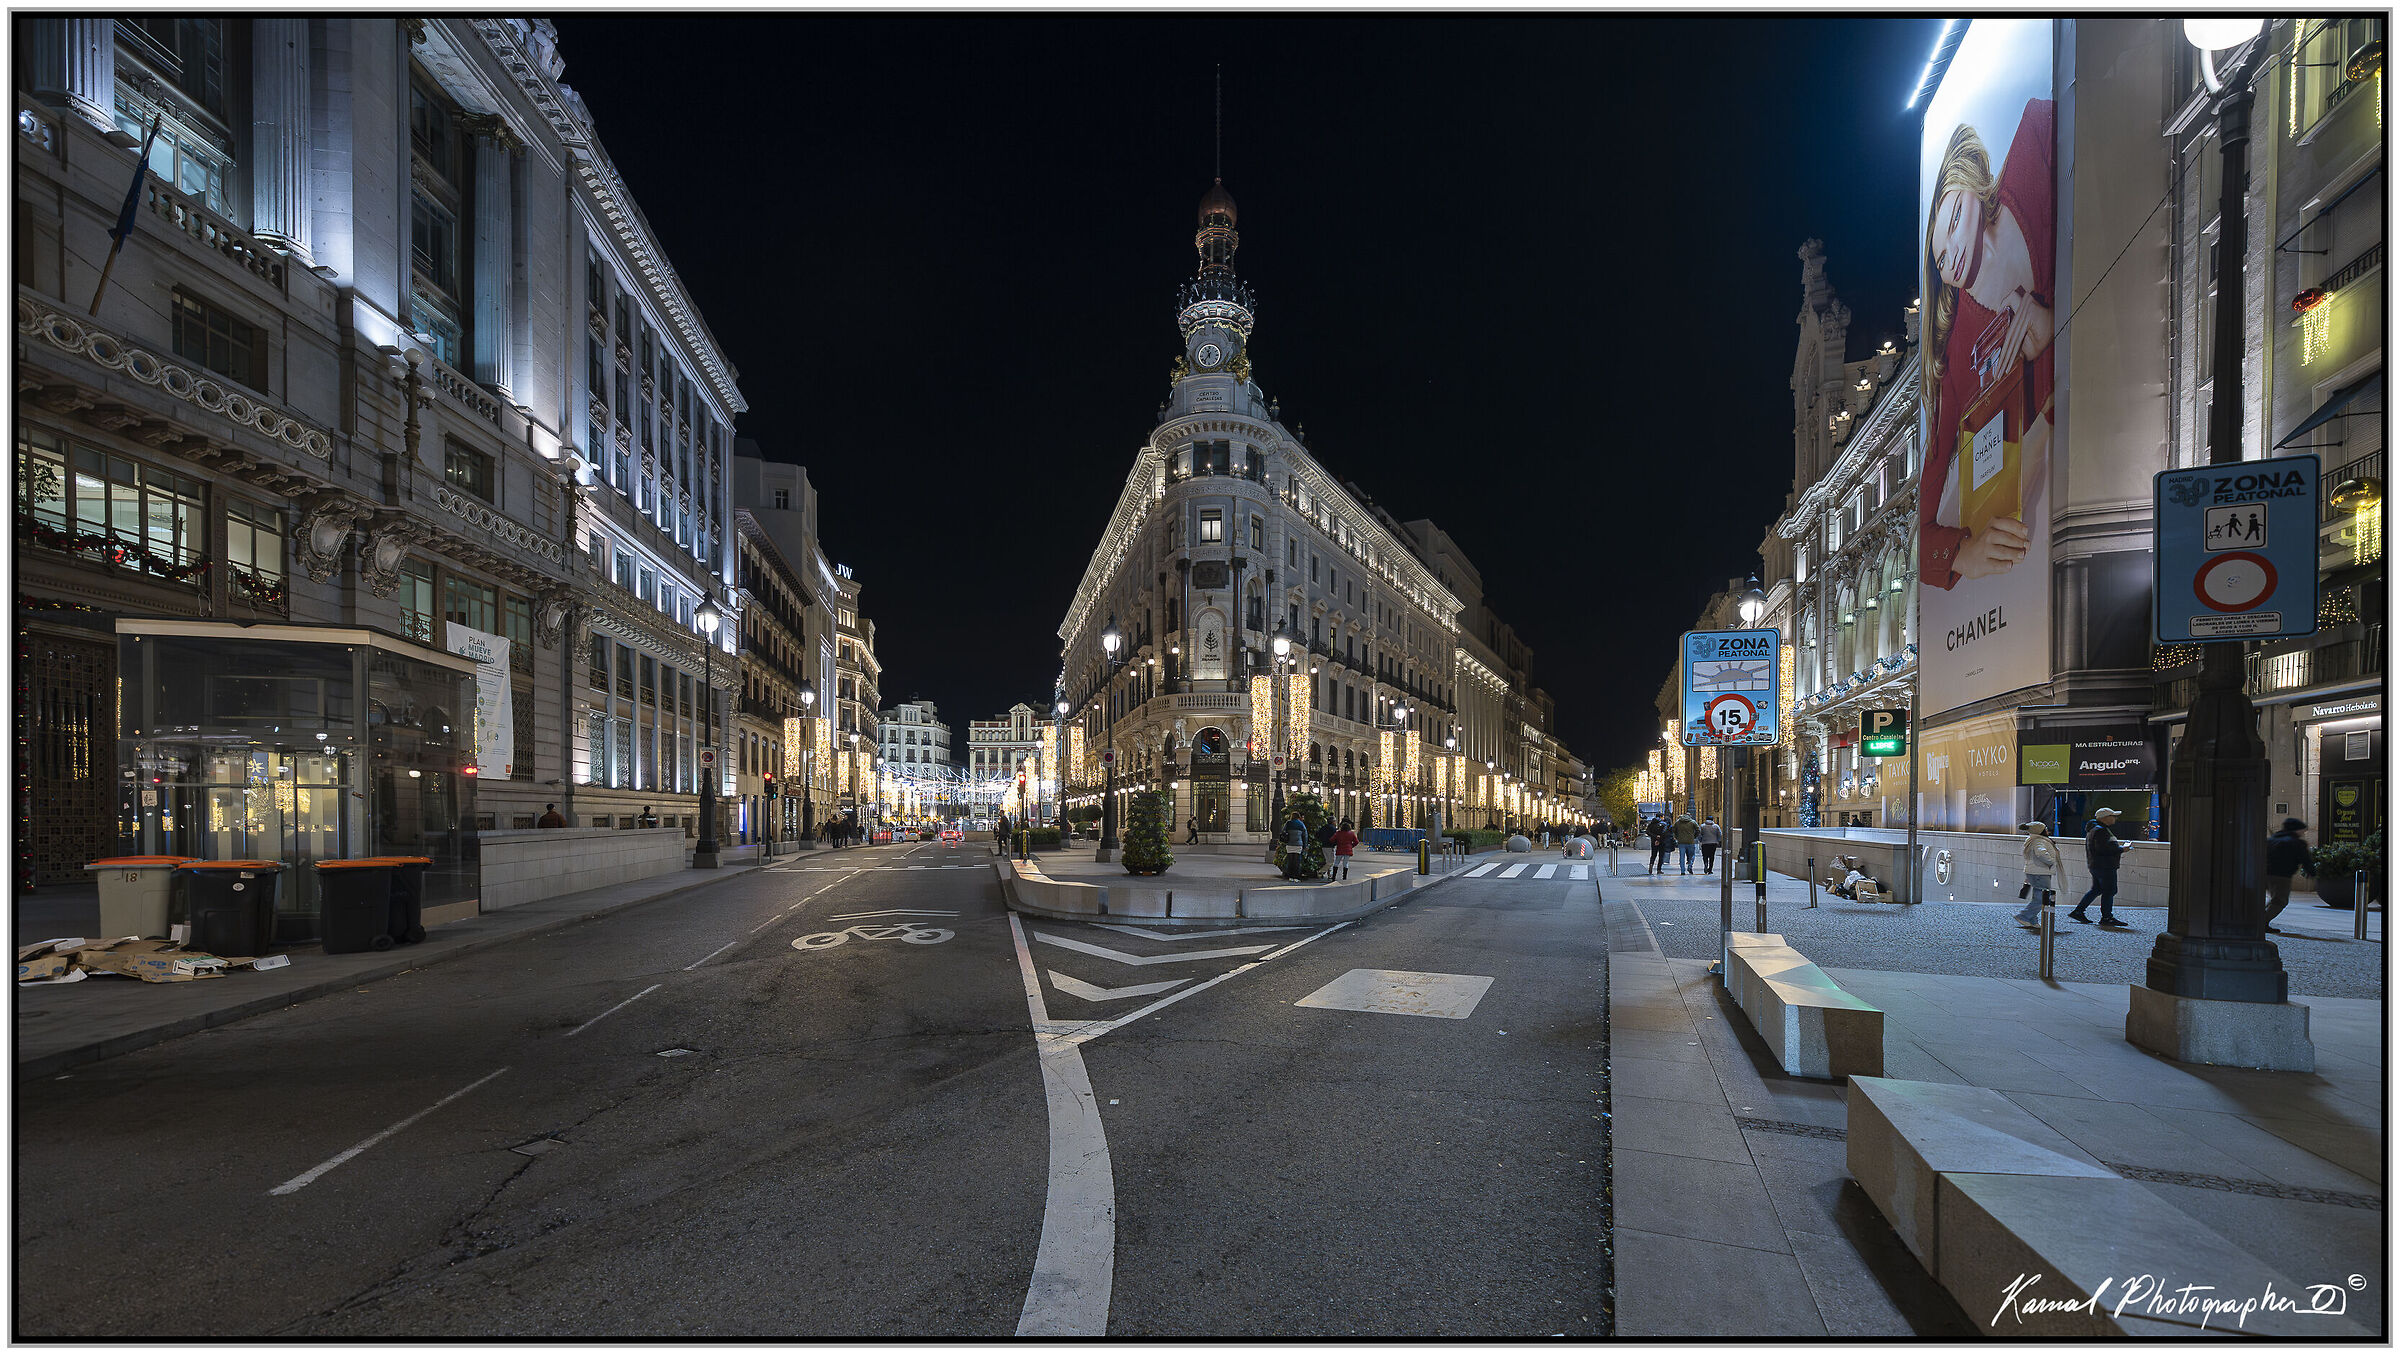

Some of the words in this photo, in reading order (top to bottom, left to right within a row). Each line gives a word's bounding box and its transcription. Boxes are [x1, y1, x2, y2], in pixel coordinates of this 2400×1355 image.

[1975, 435, 2001, 462] CHANEL
[2169, 476, 2194, 484] MADRID
[2214, 470, 2306, 494] ZONA
[2213, 487, 2306, 504] PEATONAL
[836, 563, 853, 580] JW
[1946, 605, 2007, 652] CHANEL
[468, 636, 486, 647] PLAN
[1718, 637, 1770, 650] ZONA
[468, 644, 491, 656] MUEVE
[1718, 649, 1770, 657] PEATONAL
[468, 651, 495, 664] MADRID
[2312, 706, 2345, 717] Navarro
[2345, 701, 2378, 712] Herbolario
[1719, 709, 1742, 726] 15
[1873, 712, 1894, 733] P
[1870, 741, 1895, 750] LIBRE
[2088, 740, 2143, 748] ESTRUCTURAS
[1968, 744, 2008, 768] TAYKO
[2079, 759, 2126, 771] Angulo
[125, 872, 137, 883] 18
